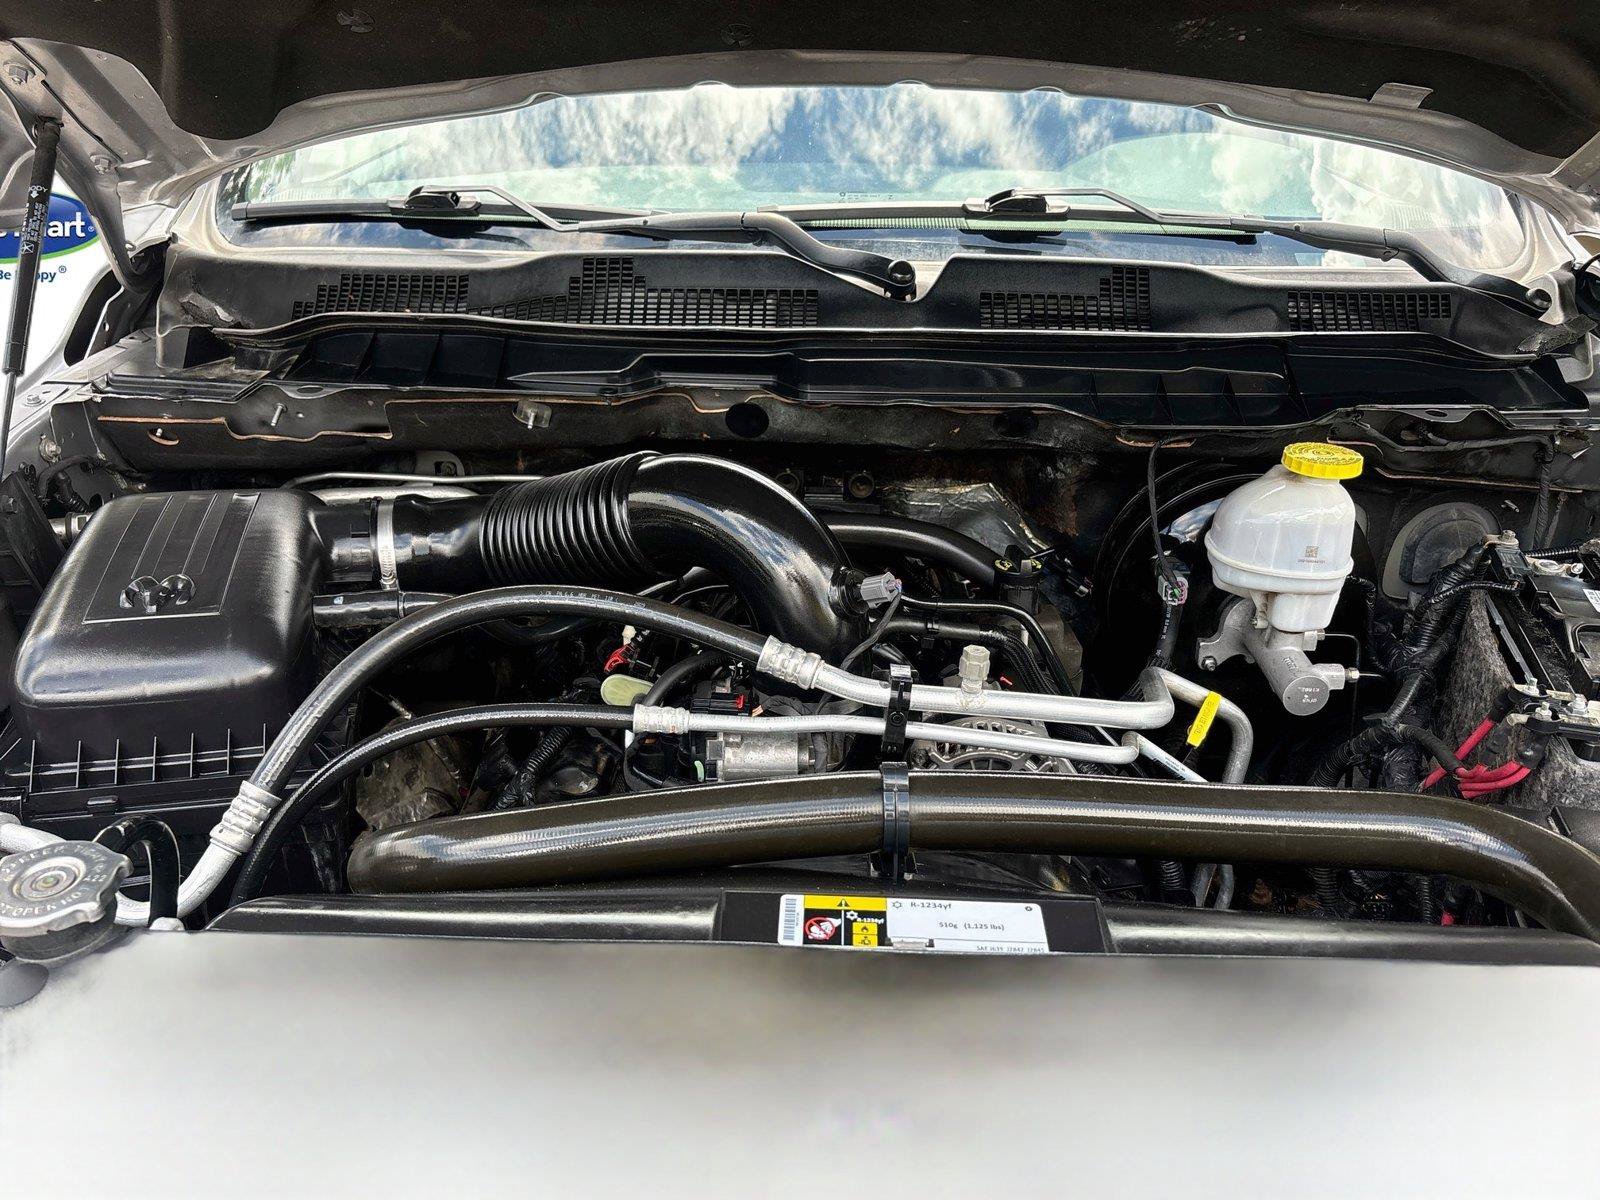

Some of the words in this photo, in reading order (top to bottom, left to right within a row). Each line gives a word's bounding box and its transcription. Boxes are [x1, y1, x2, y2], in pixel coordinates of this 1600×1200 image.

[44, 211, 86, 238] art
[910, 901, 952, 910] R-1234yf
[938, 921, 959, 930] 510g
